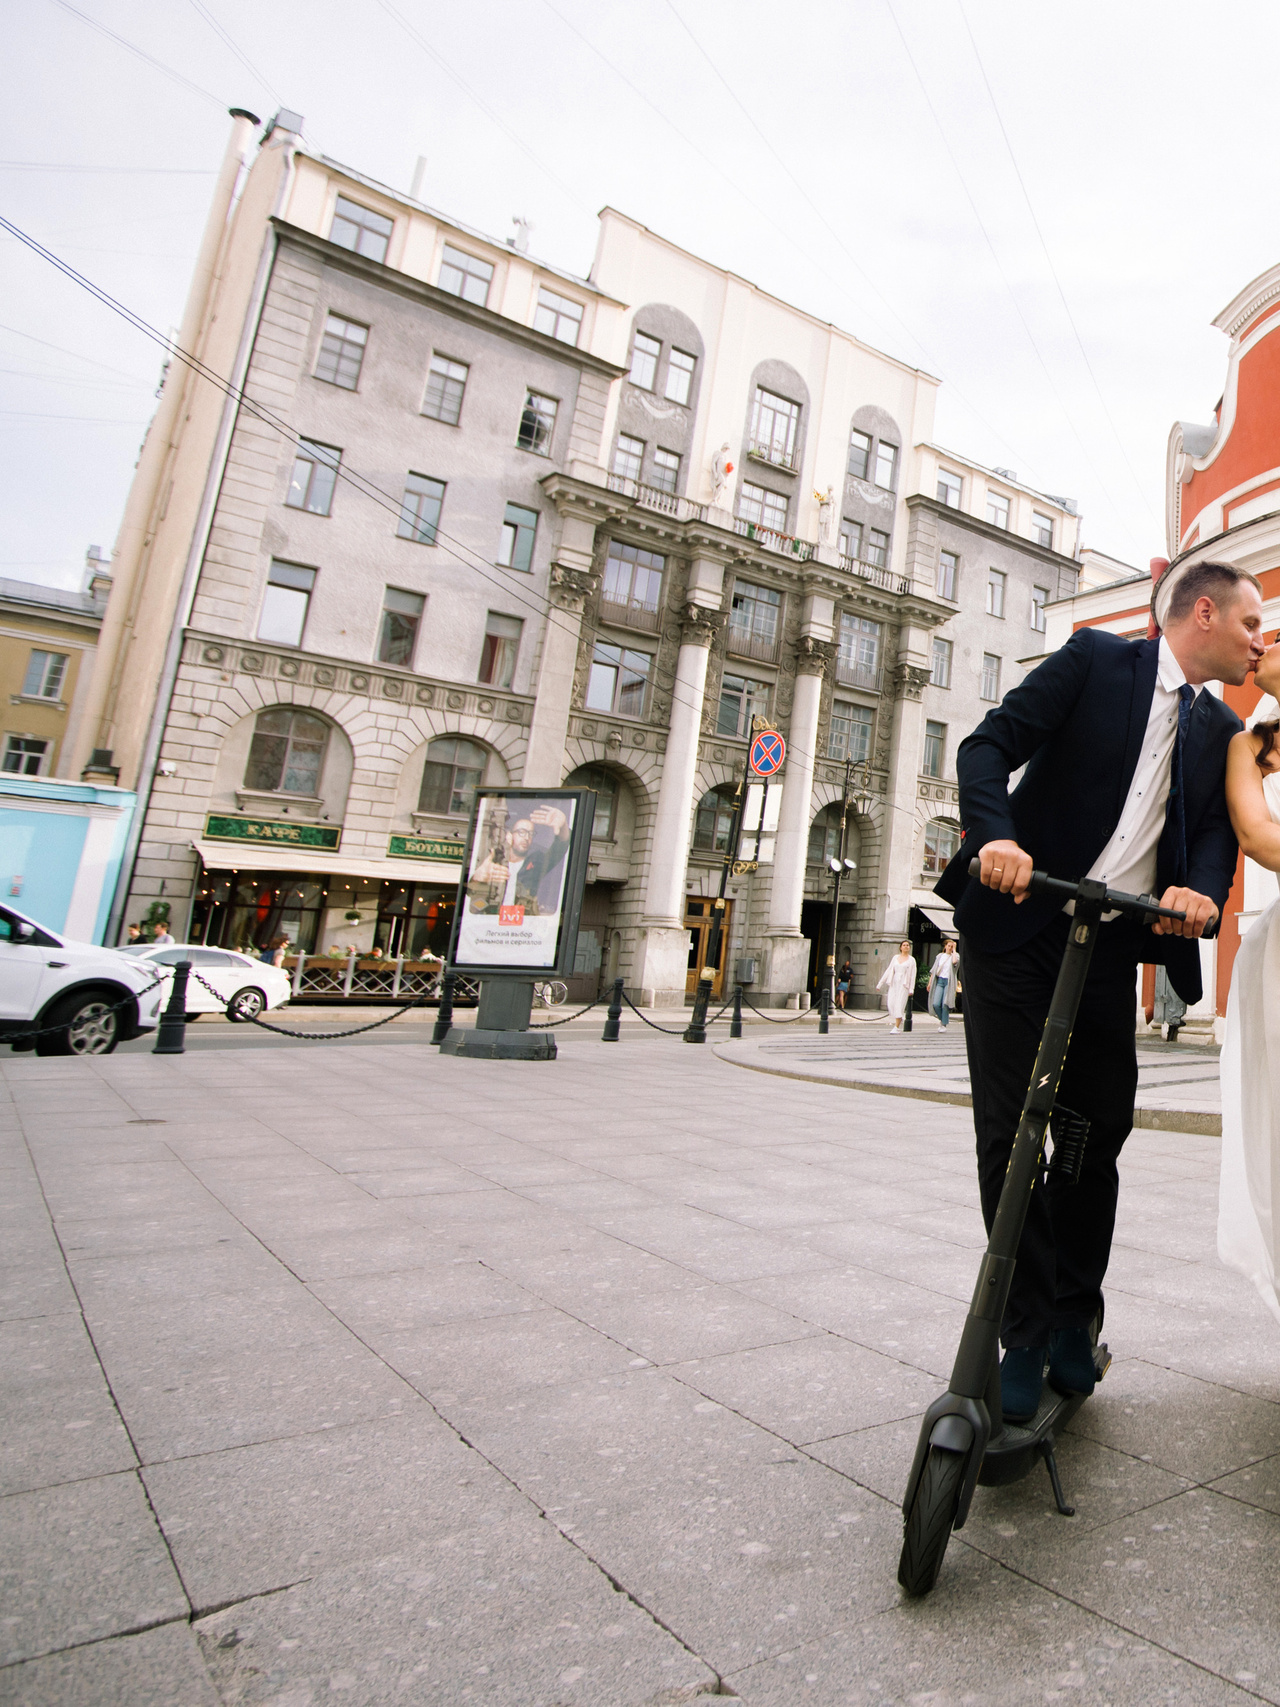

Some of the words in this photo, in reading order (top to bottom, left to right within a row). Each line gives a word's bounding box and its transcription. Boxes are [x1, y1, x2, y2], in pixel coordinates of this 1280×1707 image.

[246, 824, 301, 840] КАФЕ
[502, 910, 520, 921] ivi
[511, 930, 532, 938] выбор
